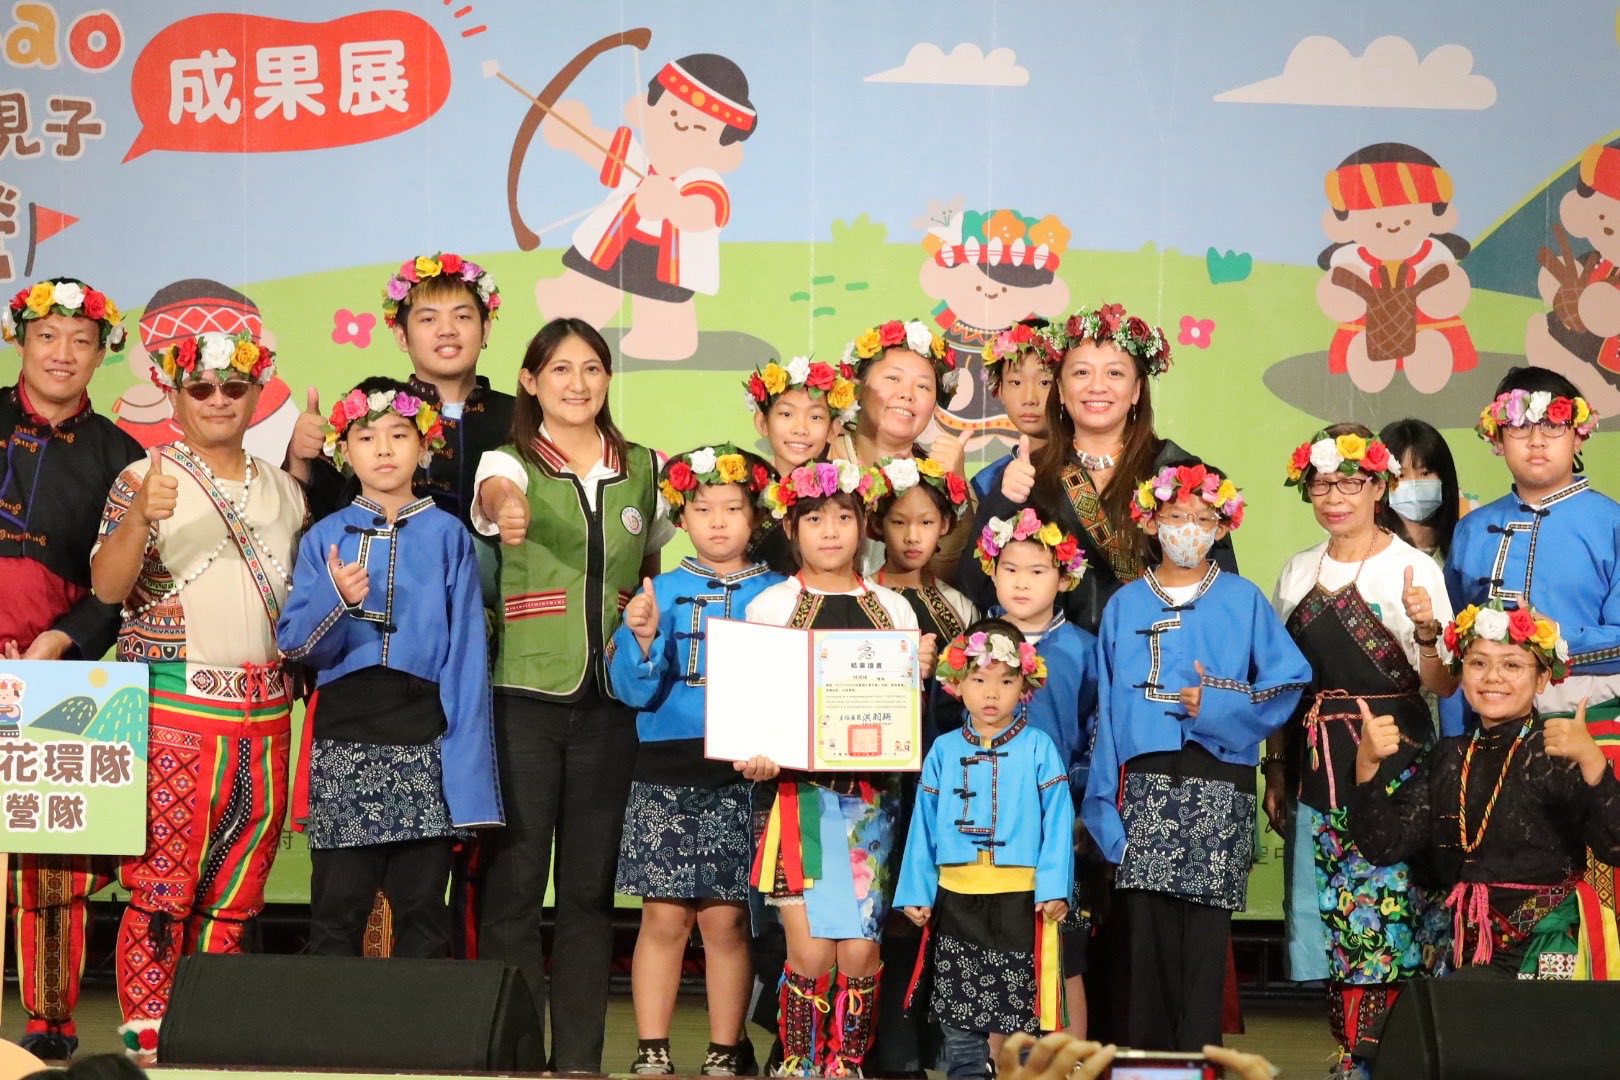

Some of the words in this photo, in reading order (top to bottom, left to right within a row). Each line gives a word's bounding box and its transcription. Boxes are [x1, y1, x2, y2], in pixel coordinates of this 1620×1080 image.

[169, 39, 409, 125] 成果展
[0, 742, 131, 784] 花環隊
[6, 793, 84, 829] 營隊
